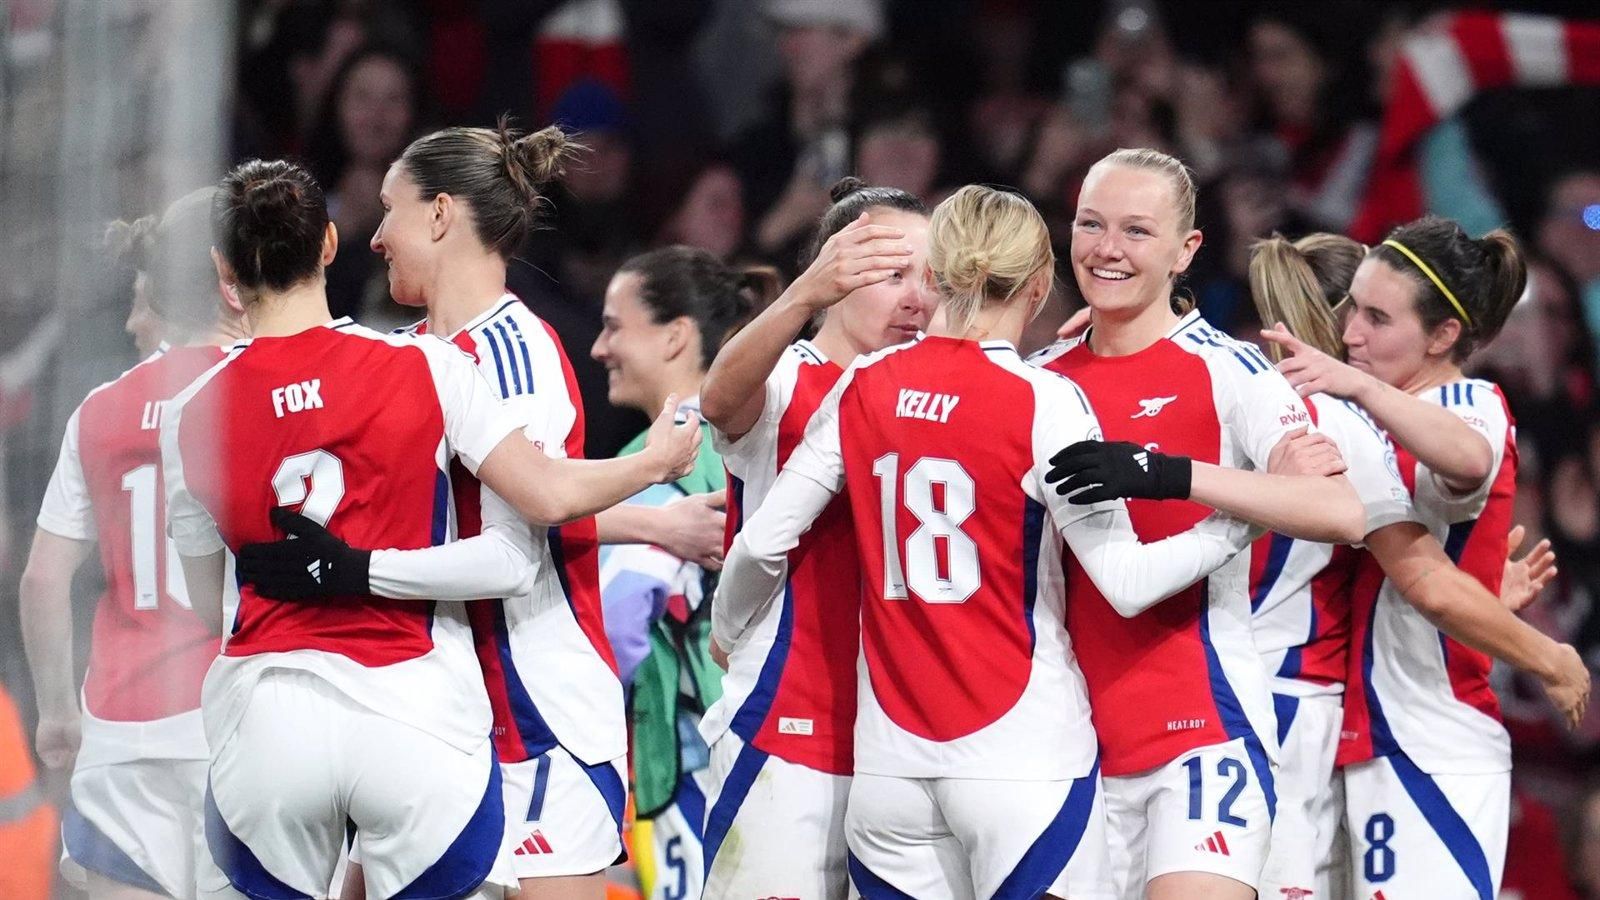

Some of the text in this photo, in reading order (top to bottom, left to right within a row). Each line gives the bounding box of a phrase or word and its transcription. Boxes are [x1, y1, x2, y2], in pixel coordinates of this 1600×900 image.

[272, 379, 323, 418] FOX
[896, 388, 960, 424] KELLY
[872, 452, 982, 604] 18
[1167, 719, 1206, 731] HEAT.RDY
[1181, 755, 1248, 828] 12
[1363, 812, 1396, 883] 8
